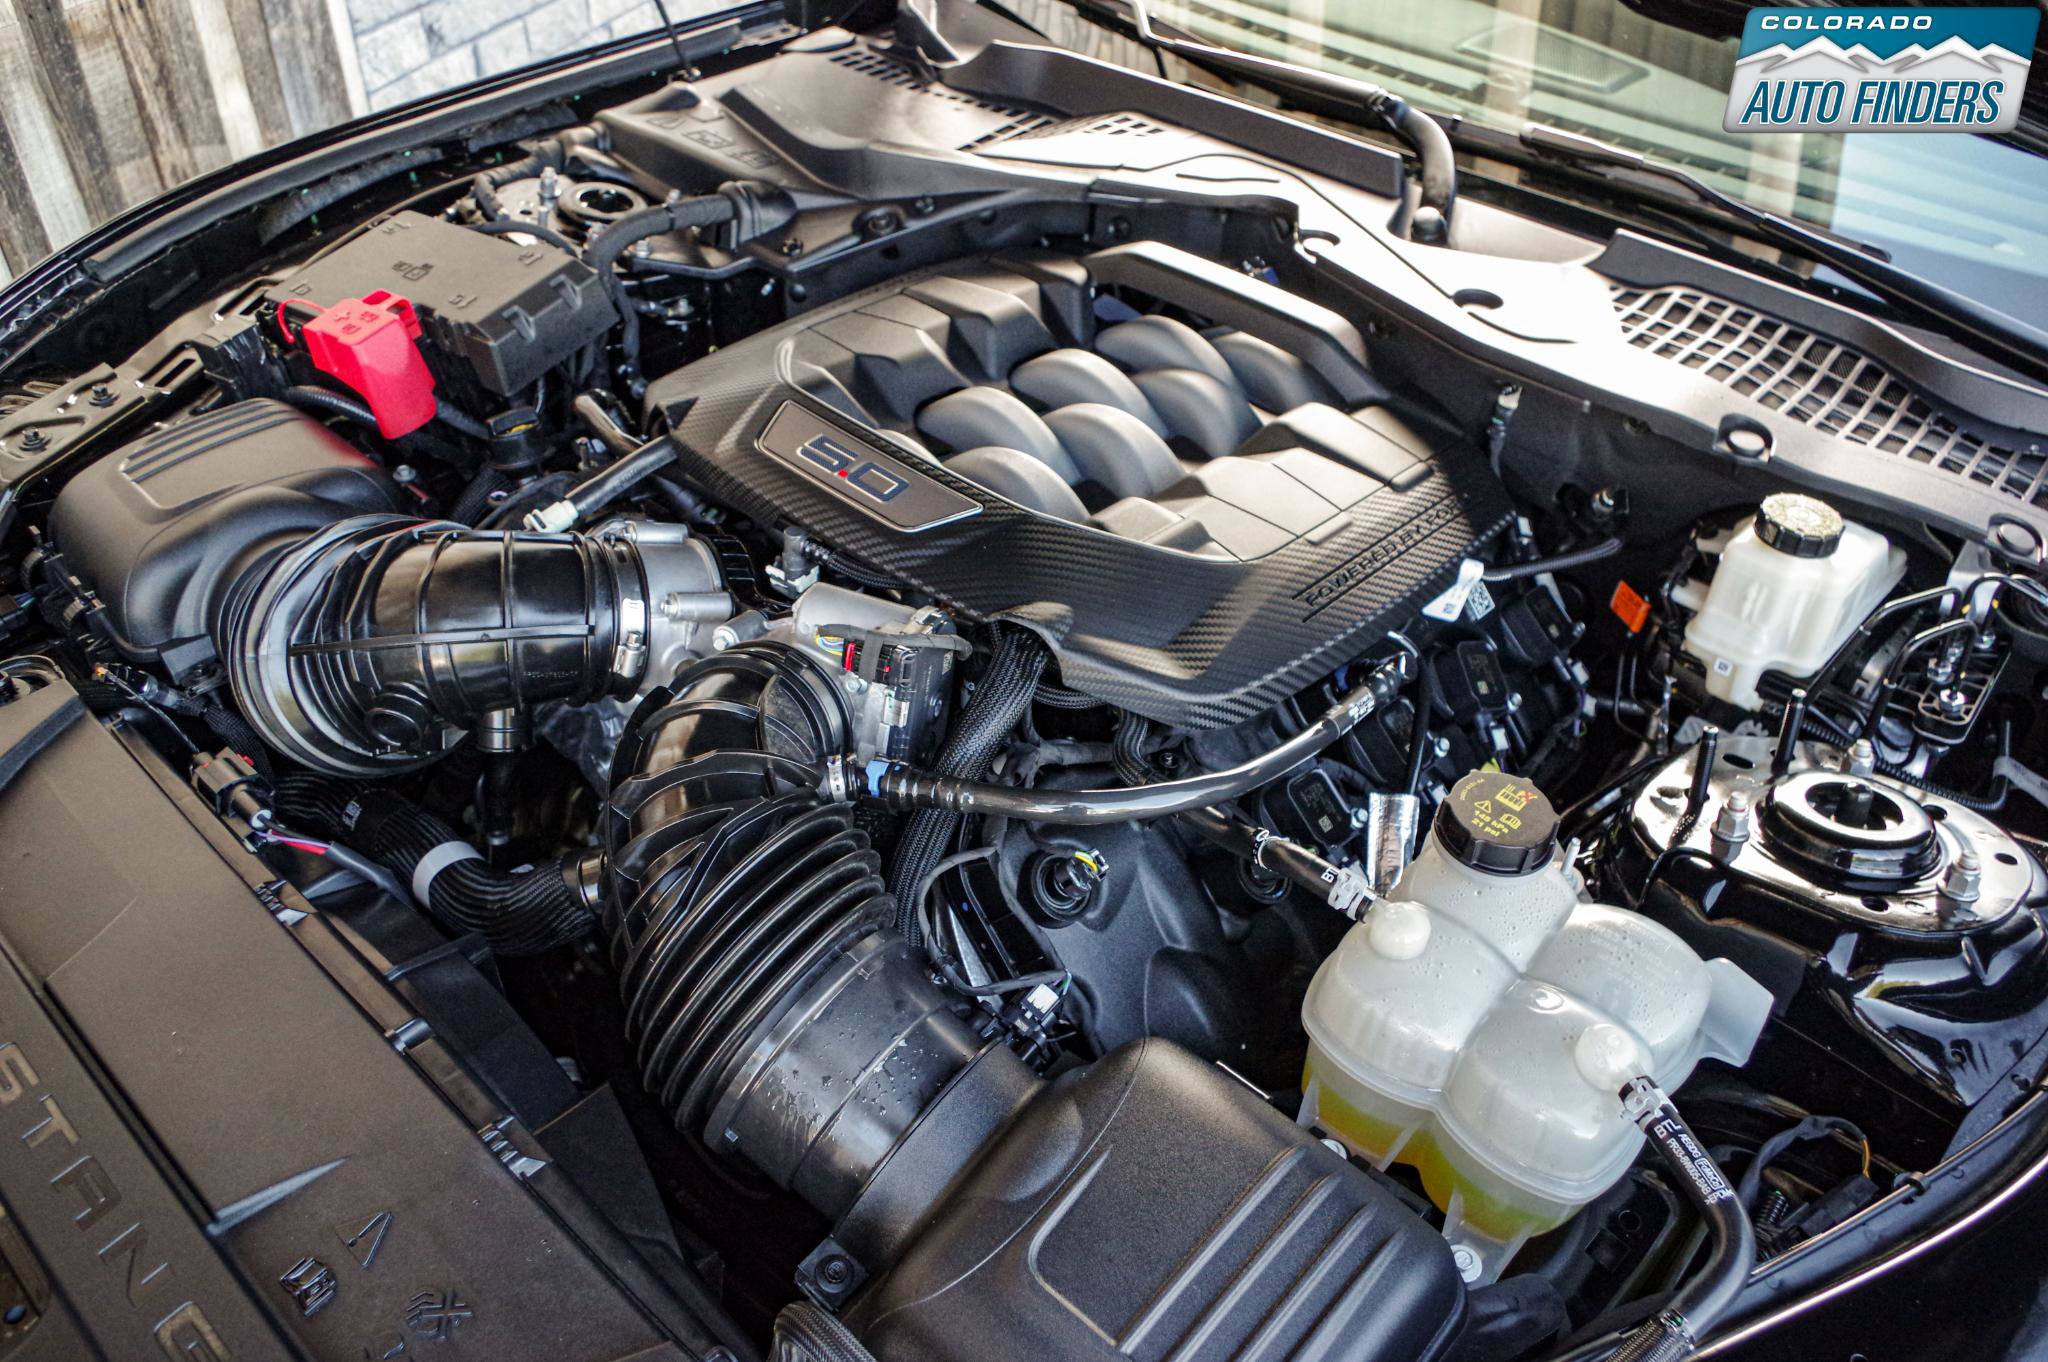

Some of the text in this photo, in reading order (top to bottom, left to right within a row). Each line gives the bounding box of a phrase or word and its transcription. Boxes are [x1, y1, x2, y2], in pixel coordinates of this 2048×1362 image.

[796, 432, 911, 504] 5.0
[1304, 541, 1399, 607] POWERED
[1400, 524, 1423, 546] BY
[1697, 1159, 1723, 1188] FoMoCo
